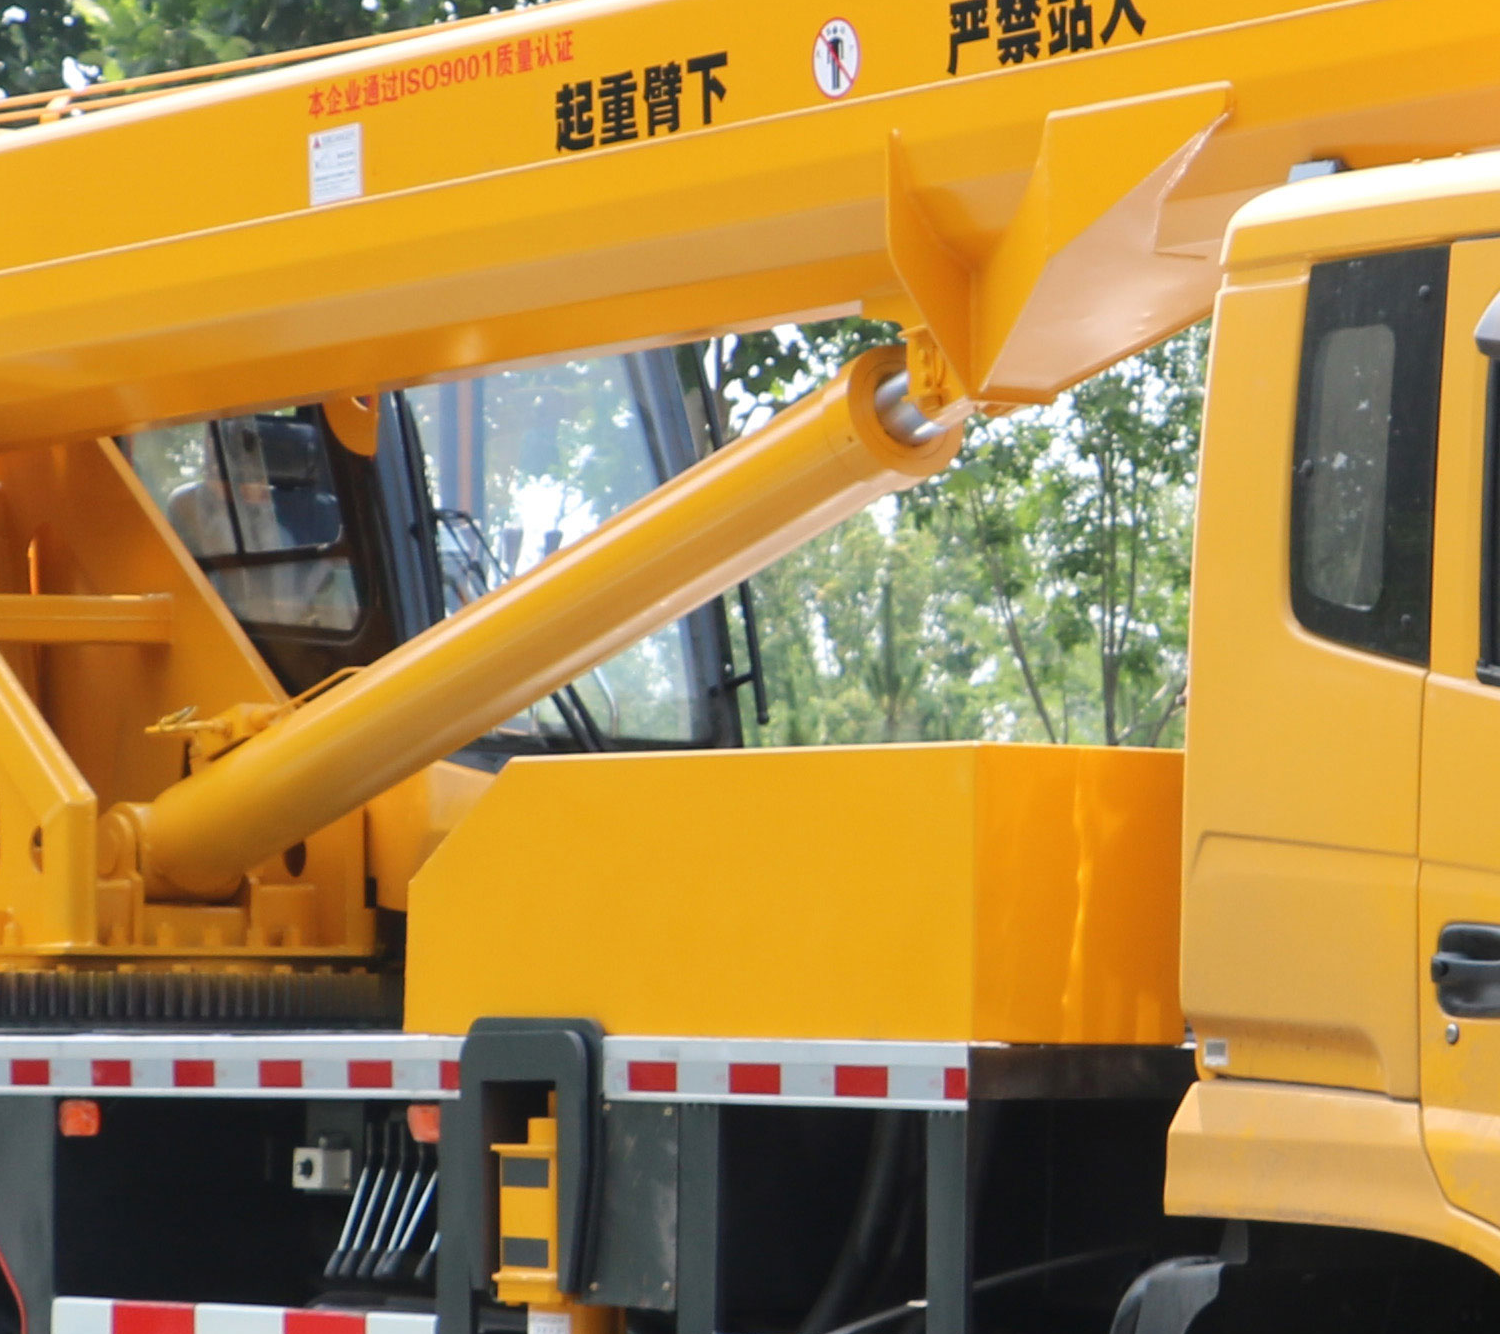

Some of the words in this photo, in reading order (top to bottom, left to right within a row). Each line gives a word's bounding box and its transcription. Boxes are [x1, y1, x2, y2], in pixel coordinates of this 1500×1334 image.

[309, 30, 574, 117] 本企业通过ISO9001质量认证
[555, 51, 728, 153] 起重臂下
